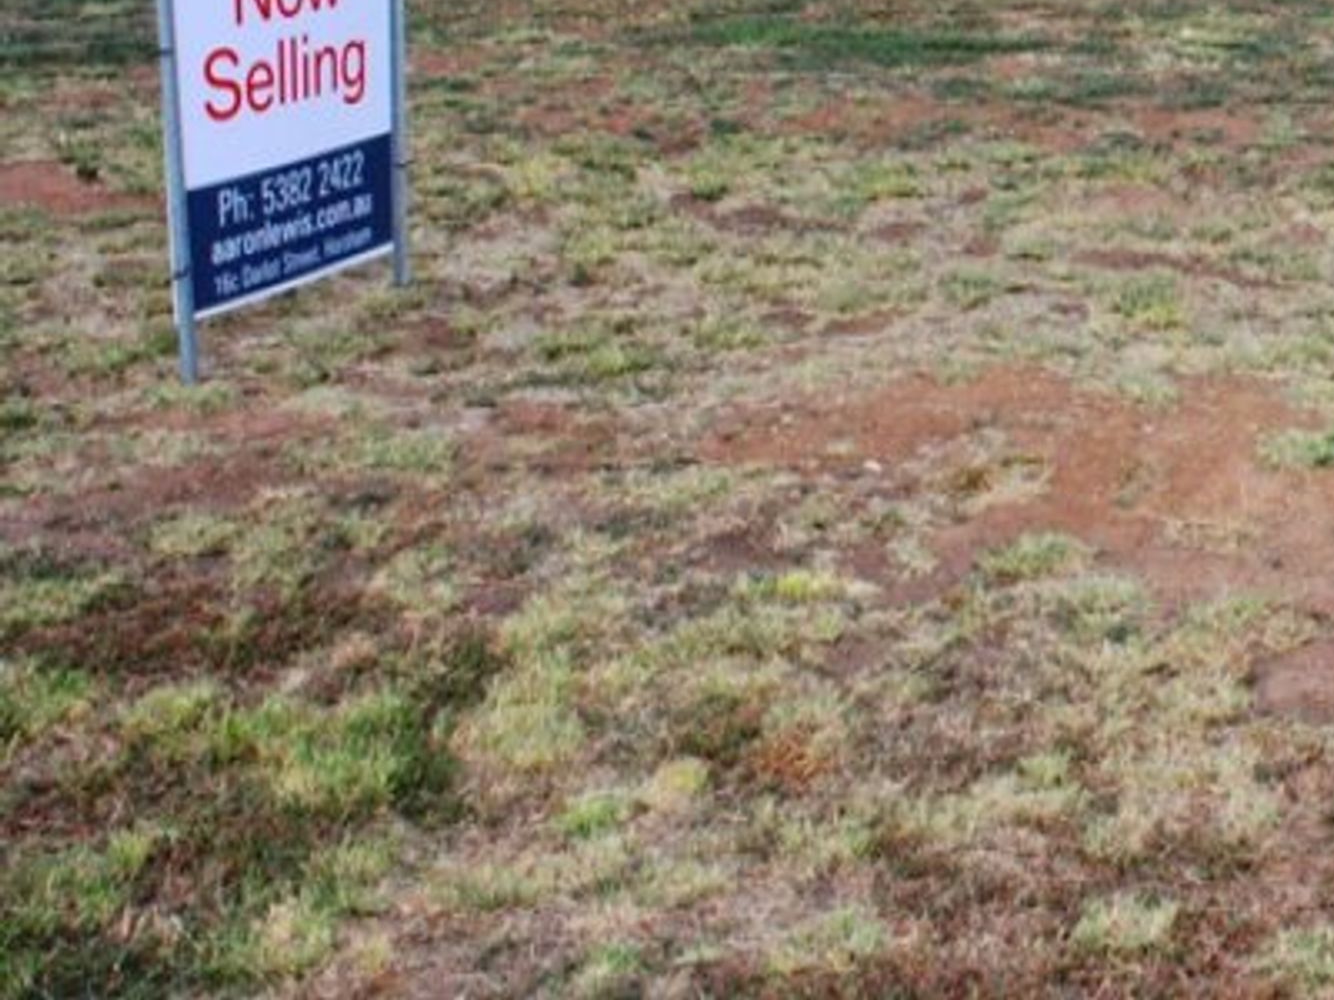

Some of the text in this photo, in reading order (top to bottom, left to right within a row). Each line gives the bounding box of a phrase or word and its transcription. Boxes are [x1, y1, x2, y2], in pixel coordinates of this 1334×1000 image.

[204, 34, 366, 121] Selling
[218, 150, 365, 227] Ph: 5382 2422
[211, 194, 373, 265] aaronlewis.com.au
